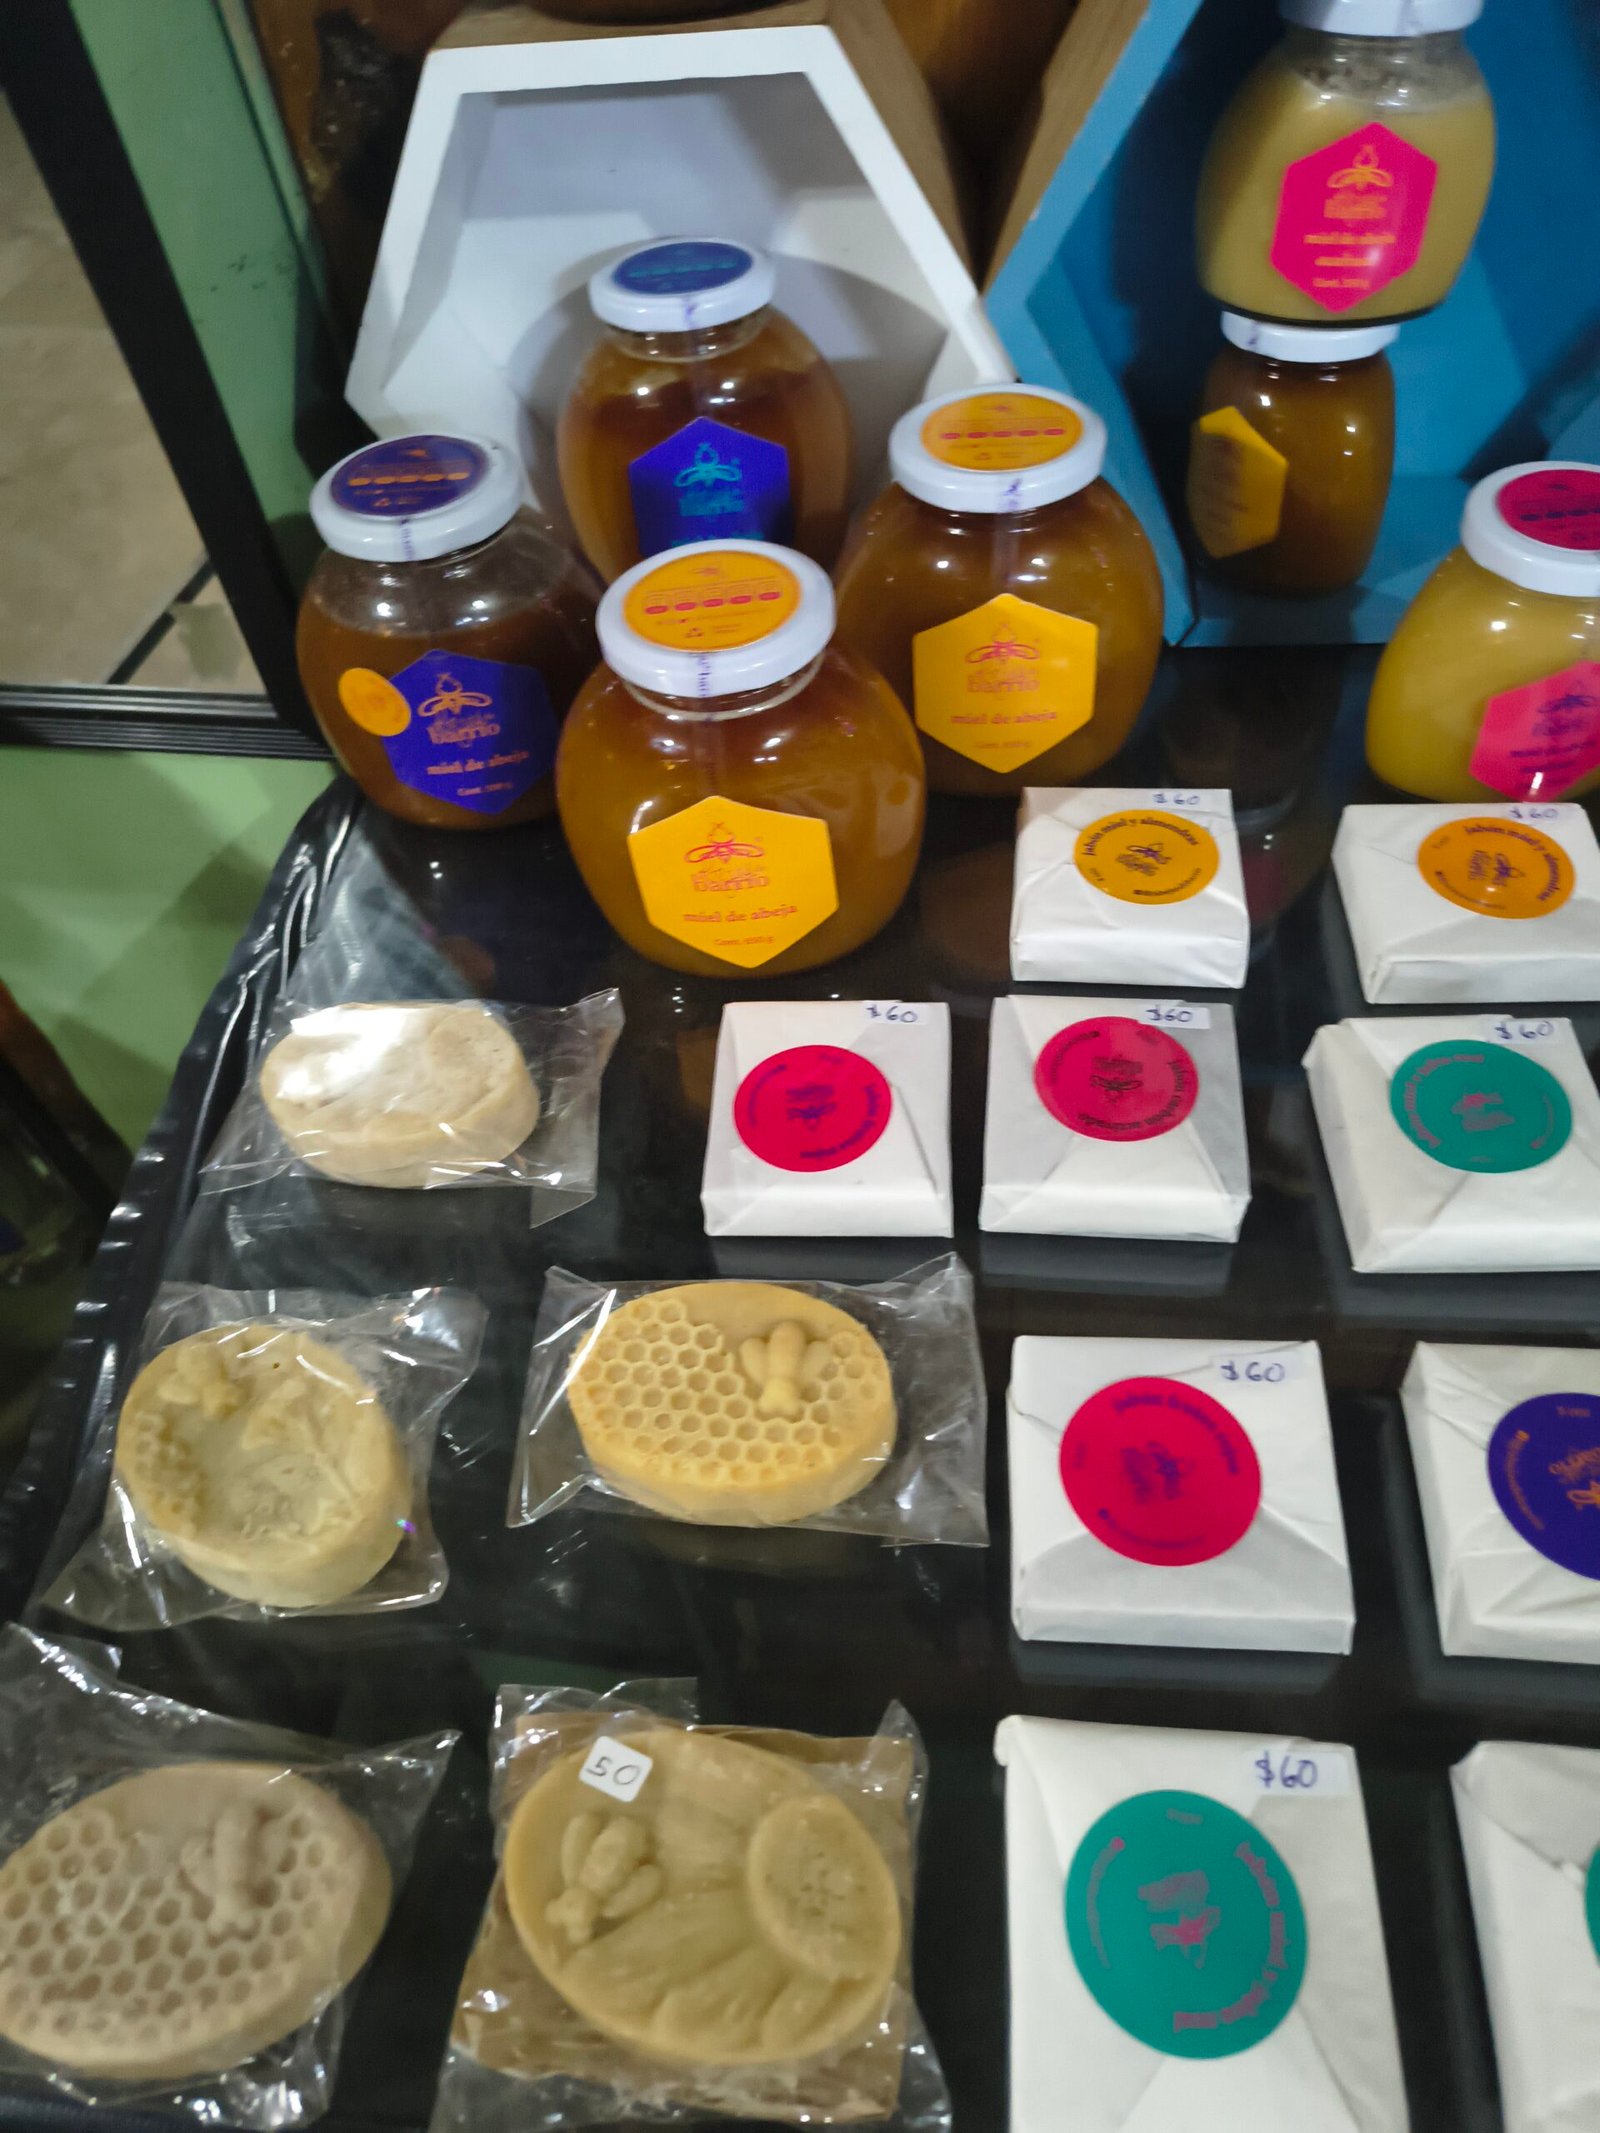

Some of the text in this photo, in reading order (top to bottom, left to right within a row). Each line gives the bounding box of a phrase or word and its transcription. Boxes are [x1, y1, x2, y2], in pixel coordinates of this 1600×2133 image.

[951, 708, 1057, 725] miel de abeja
[426, 760, 464, 776] miel
[464, 758, 486, 772] de
[1153, 792, 1201, 806] $60
[1509, 806, 1559, 820] $60
[1100, 818, 1128, 834] miel
[1140, 816, 1199, 847] almendras
[683, 903, 798, 923] miel de abeja
[866, 1003, 919, 1024] $60
[1145, 1004, 1194, 1023] $60
[1493, 1020, 1556, 1041] $60
[1220, 1360, 1286, 1383] $60
[586, 1756, 641, 1786] 50
[1255, 1751, 1318, 1789] $60
